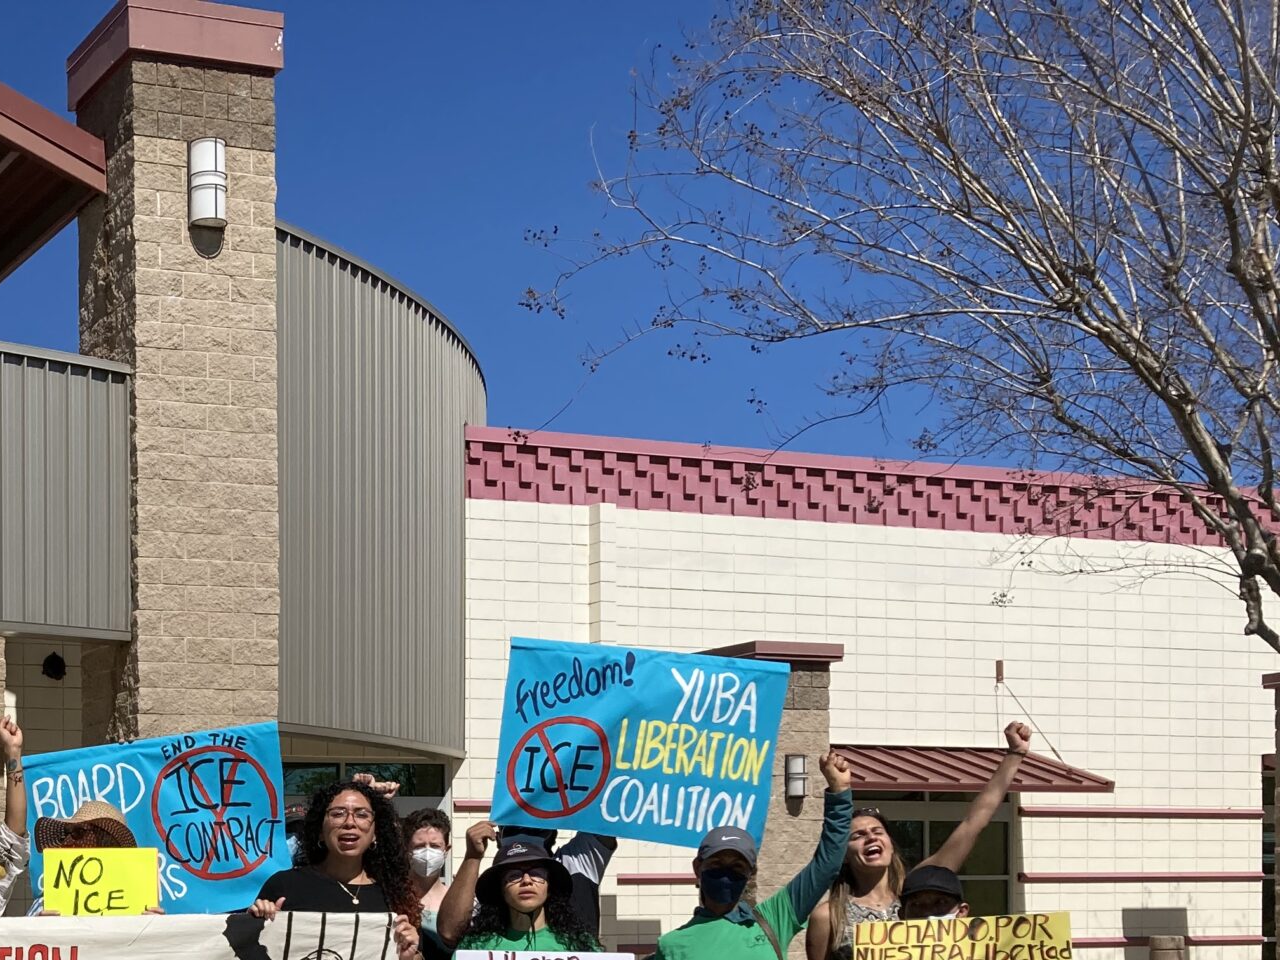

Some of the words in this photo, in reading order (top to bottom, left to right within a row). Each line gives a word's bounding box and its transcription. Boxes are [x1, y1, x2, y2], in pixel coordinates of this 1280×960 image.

[670, 667, 758, 733] YUBA
[161, 734, 196, 761] END
[208, 733, 248, 751] THE
[520, 742, 600, 793] ICE
[615, 718, 770, 786] LIBERATION
[32, 762, 146, 820] BOARD
[163, 757, 252, 816] ICE
[600, 775, 757, 833] COALITION
[166, 815, 283, 864] CONTRACT
[53, 854, 104, 889] NO
[73, 889, 130, 915] ICE
